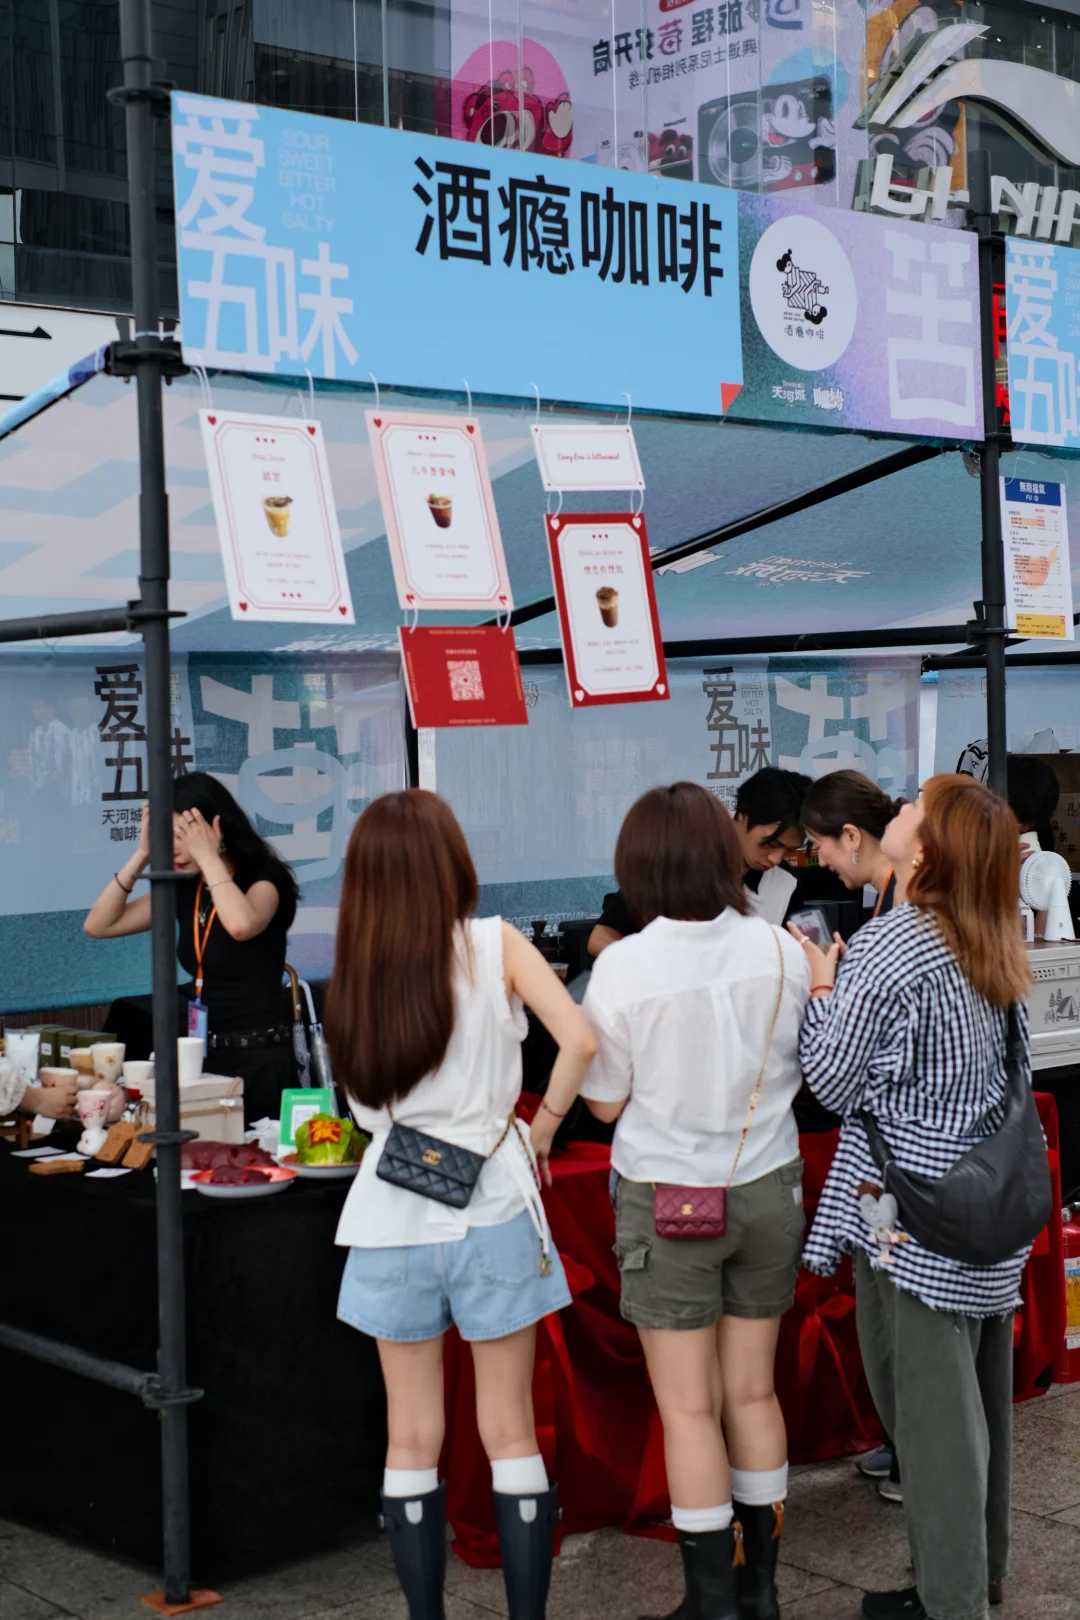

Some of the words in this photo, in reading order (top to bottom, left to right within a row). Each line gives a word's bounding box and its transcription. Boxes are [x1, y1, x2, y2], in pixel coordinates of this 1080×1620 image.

[281, 129, 330, 152] SOUR
[175, 98, 265, 247] 爱
[277, 149, 336, 173] SWEET
[278, 170, 337, 194] BITTER
[289, 192, 326, 213] HOT
[281, 210, 335, 233] SALTY
[413, 156, 724, 297] 酒瘾咖啡
[182, 231, 359, 379] 五味
[1008, 241, 1058, 350] 爱
[772, 386, 806, 403] 天河城
[742, 673, 760, 682] SOUR
[94, 664, 144, 733] 爱
[702, 666, 738, 724] 爱
[741, 690, 764, 699] BITTER
[746, 699, 760, 707] HOT
[743, 708, 763, 716] SALTY
[706, 719, 771, 780] 五味
[110, 826, 141, 842] 咖啡
